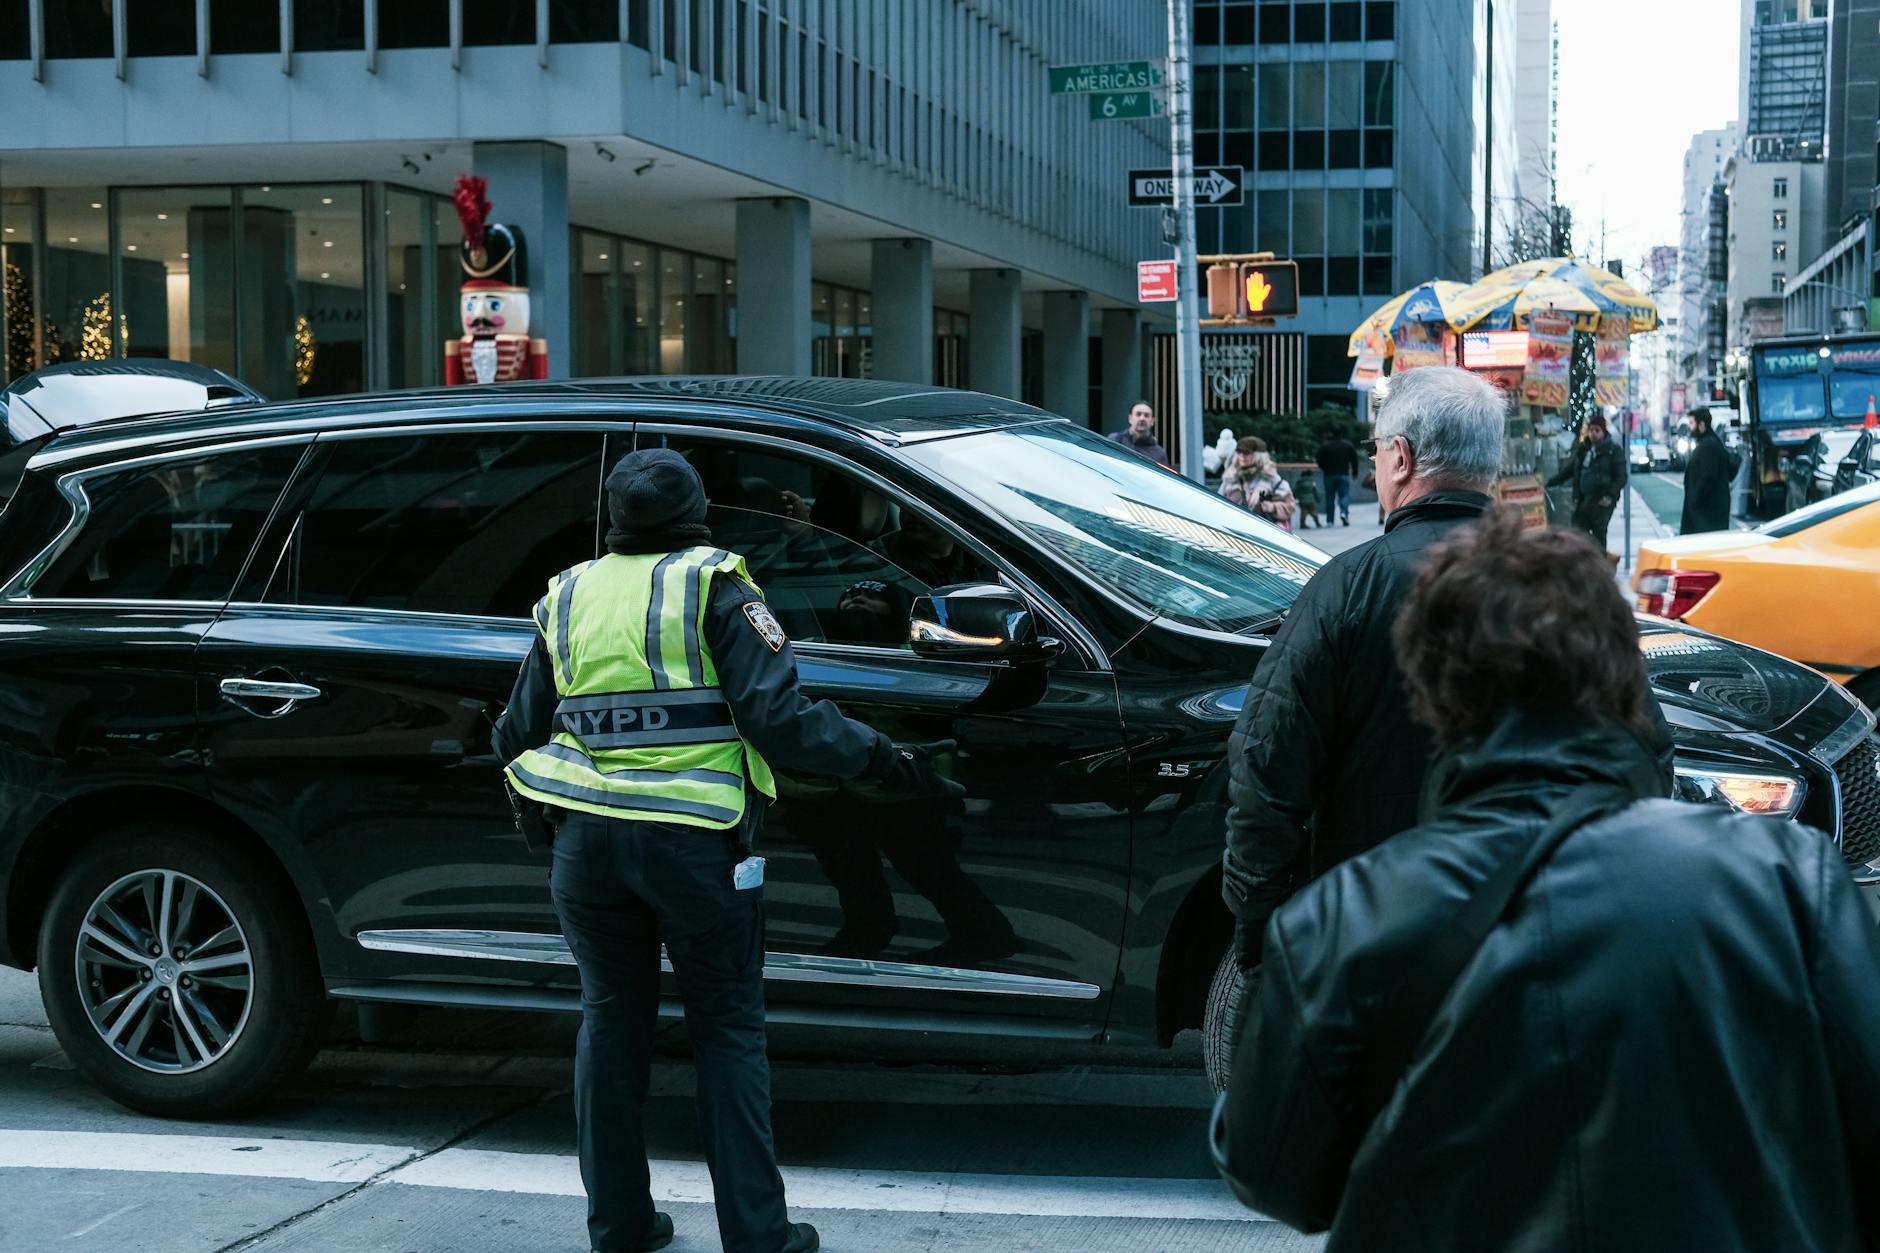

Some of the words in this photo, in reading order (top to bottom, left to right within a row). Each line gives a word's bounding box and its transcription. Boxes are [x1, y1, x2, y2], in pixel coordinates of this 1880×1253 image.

[1064, 71, 1148, 92] AMERICAS
[1102, 96, 1117, 117] 6
[1122, 94, 1138, 106] AV
[1144, 180, 1174, 195] ONE
[1765, 352, 1818, 374] TOXIC
[561, 706, 670, 736] NYPD
[1158, 762, 1190, 778] 3.5
